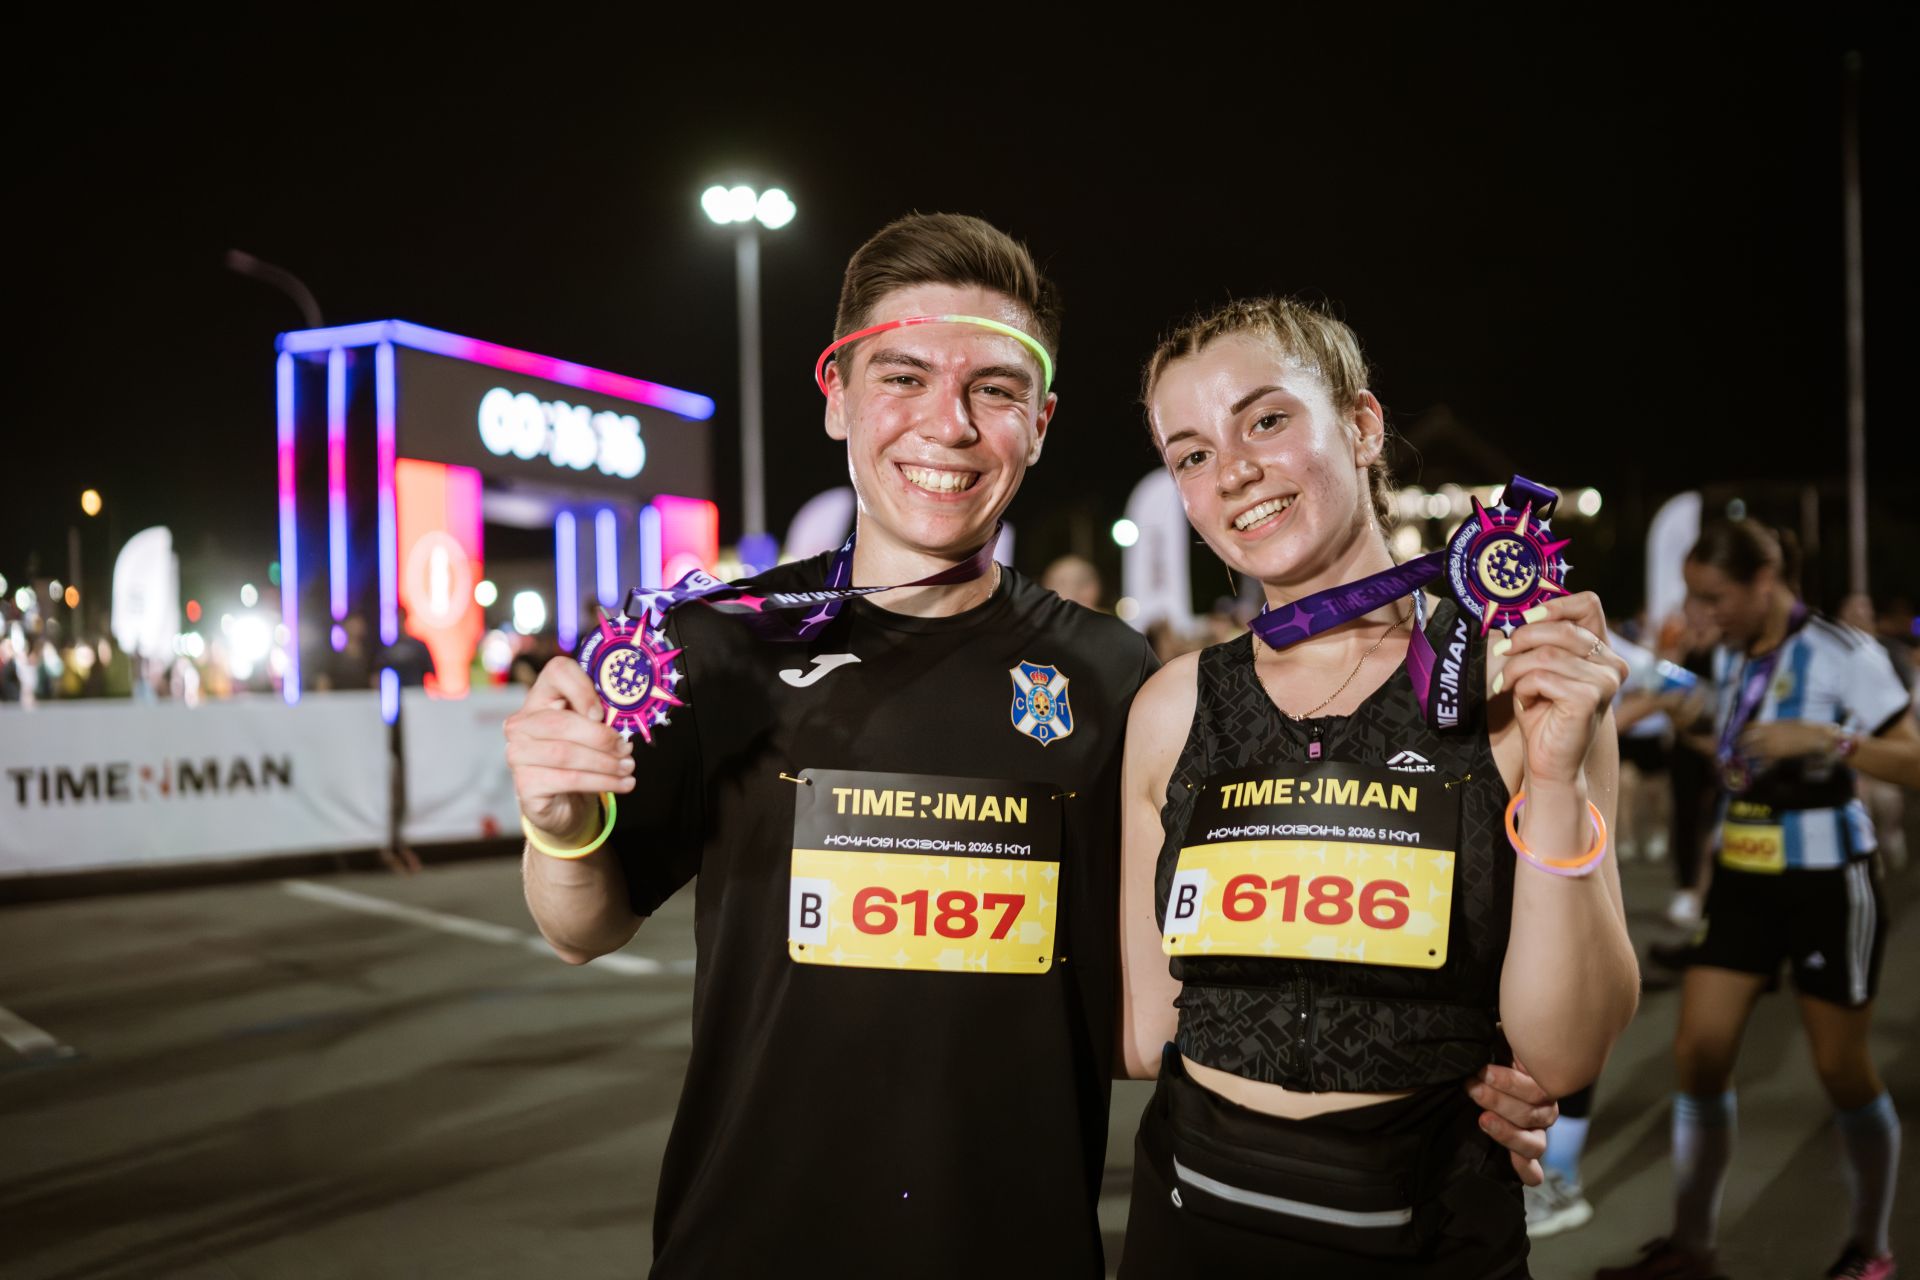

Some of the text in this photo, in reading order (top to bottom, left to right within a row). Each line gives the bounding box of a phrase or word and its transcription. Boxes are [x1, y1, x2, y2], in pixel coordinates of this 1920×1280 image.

[1016, 697, 1025, 710] C
[1058, 702, 1066, 715] T
[1039, 725, 1049, 739] D
[832, 788, 1028, 824] TIMERMAN
[1220, 778, 1418, 812] TIMERMAN
[968, 841, 993, 853] 2026
[995, 843, 1003, 854] 5
[1347, 826, 1376, 839] 2026
[1378, 828, 1387, 839] 5
[800, 892, 822, 929] B
[852, 886, 1026, 940] 6187
[1175, 883, 1198, 919] B
[1221, 873, 1411, 931] 6186
